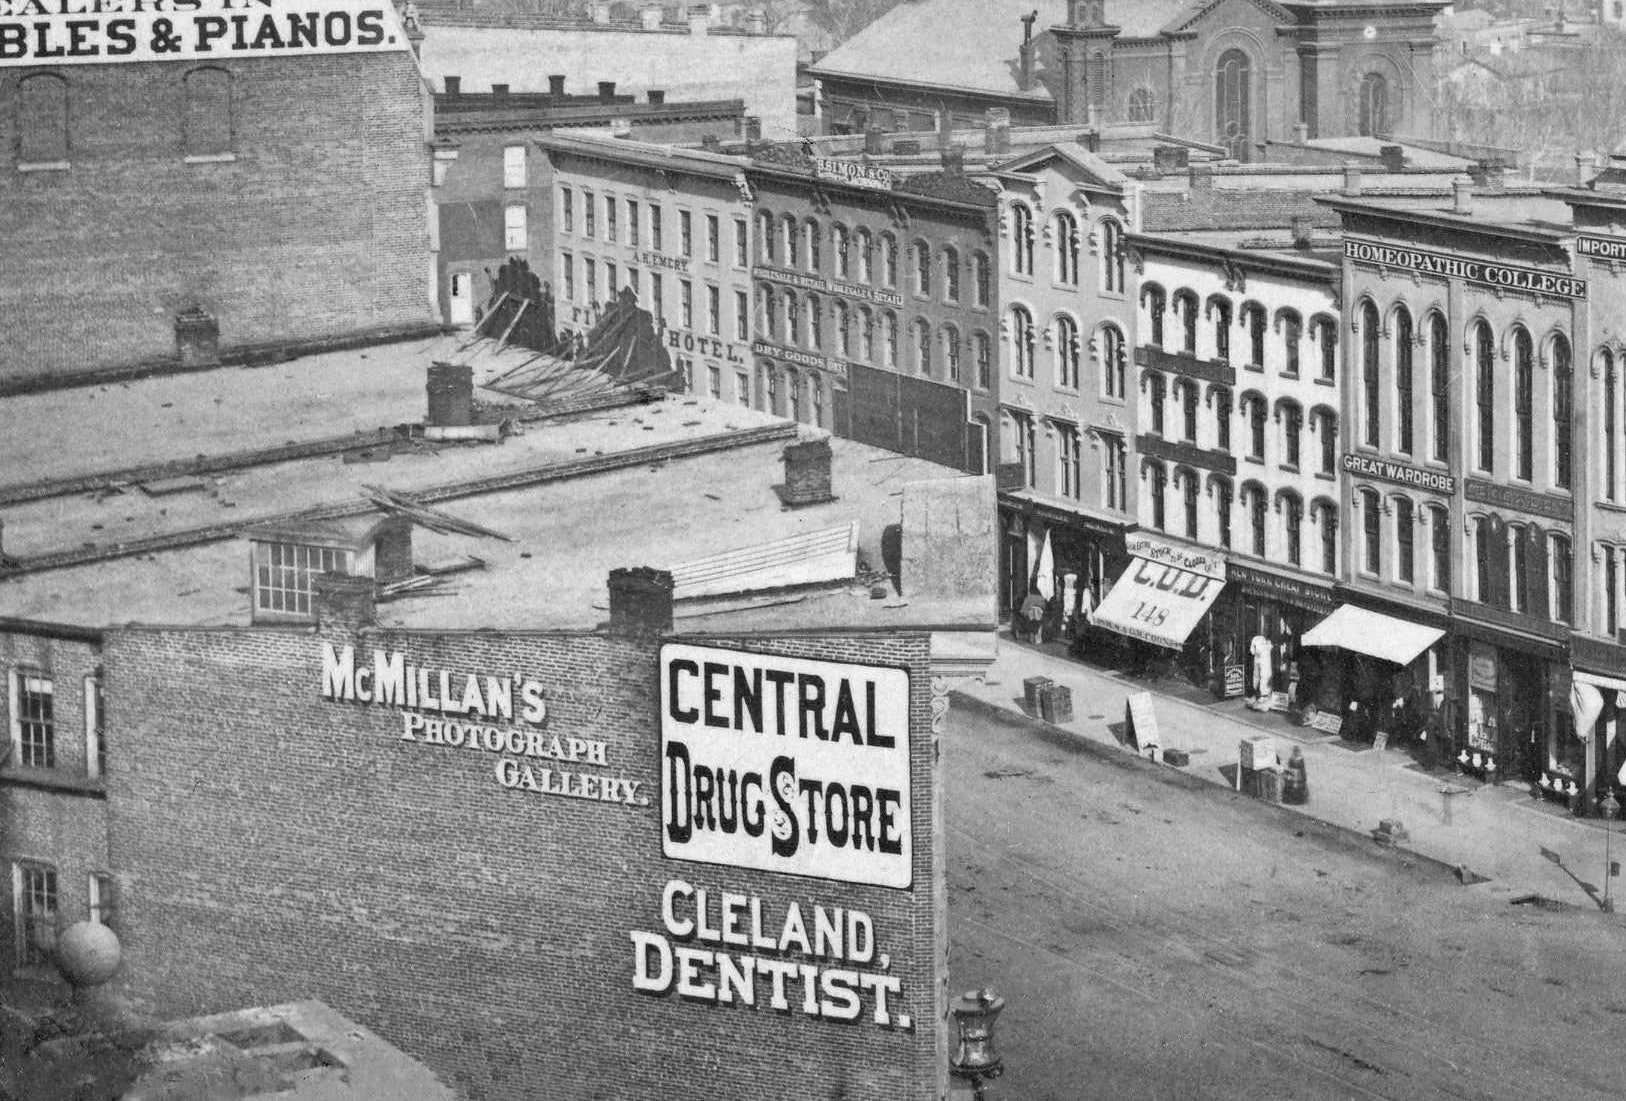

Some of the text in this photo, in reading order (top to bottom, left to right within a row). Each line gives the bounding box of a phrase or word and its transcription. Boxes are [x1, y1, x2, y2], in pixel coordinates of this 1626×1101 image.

[150, 18, 182, 54] &
[193, 10, 396, 52] PIANOS.
[1345, 240, 1585, 297] HOMEOPATHIC COLLEGE
[669, 329, 743, 364] HOTEL.
[756, 343, 782, 358] DRY
[785, 349, 826, 367] GOODS
[1343, 454, 1454, 491] GREAT WARDROBE
[1184, 556, 1206, 568] CLOSED
[1131, 601, 1169, 627] 148
[668, 658, 896, 750] CENTRAL
[400, 711, 608, 766] PHOTOGRAPH
[495, 758, 650, 806] GALLERY.
[666, 740, 903, 858] DRUG STORE
[662, 879, 890, 971] CLELAND,
[630, 929, 911, 1028] DENTIST.
